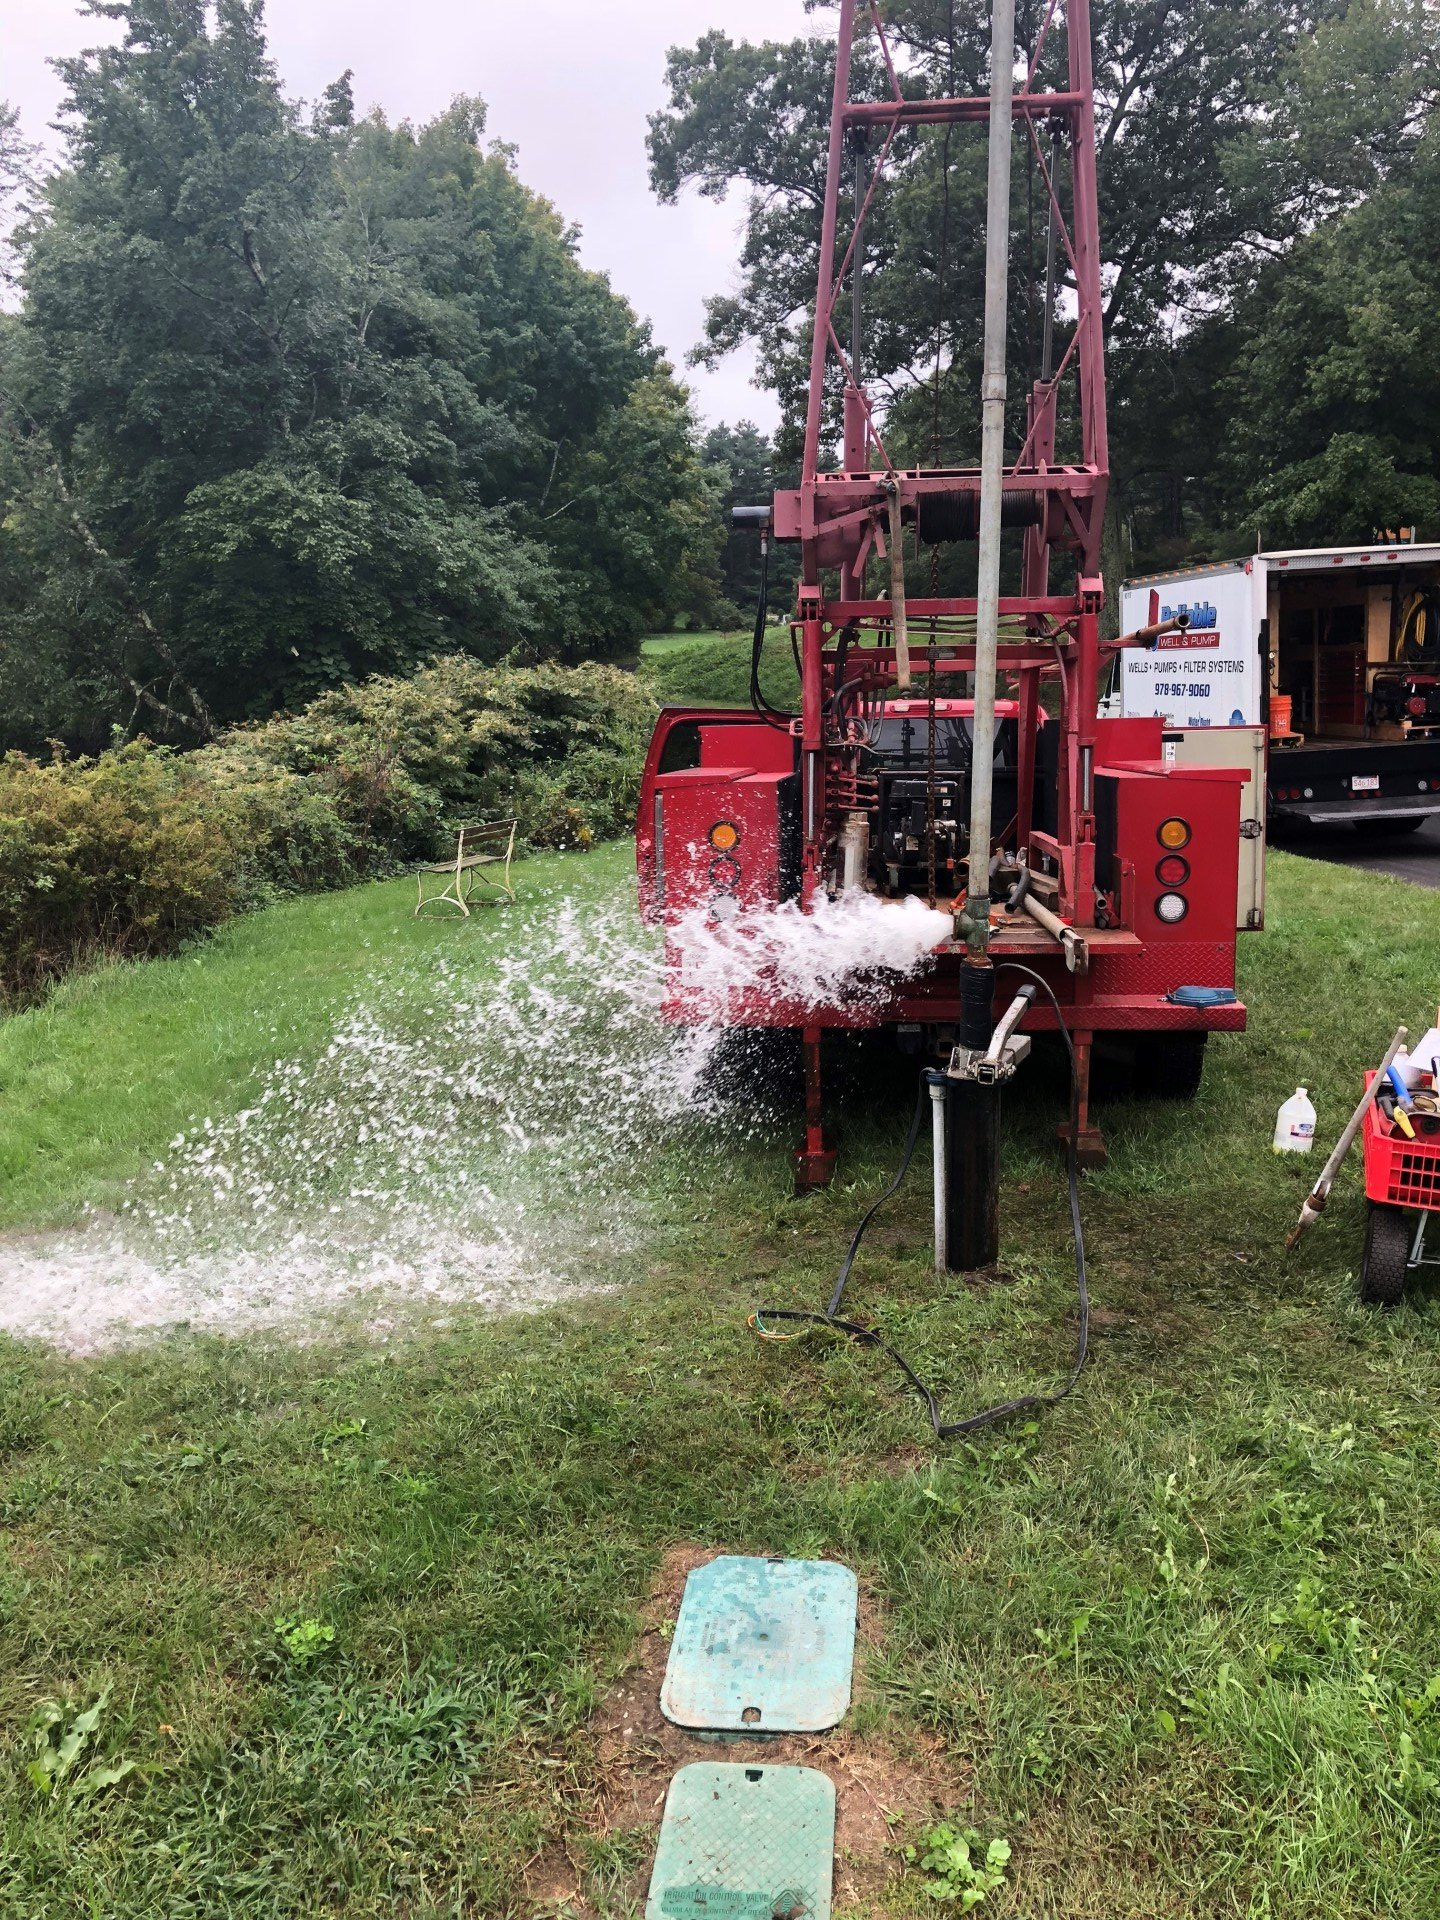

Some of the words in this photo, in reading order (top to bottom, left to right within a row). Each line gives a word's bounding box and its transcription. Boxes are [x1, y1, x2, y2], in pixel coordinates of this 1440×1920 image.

[1160, 637, 1180, 647] WELL
[1182, 637, 1188, 646] &
[1191, 635, 1216, 645] PUMP
[1128, 662, 1149, 673] WELLS
[1154, 661, 1178, 673] PUMPS
[1183, 661, 1207, 673] FILTER
[1208, 660, 1245, 673] SYSTEMS
[1154, 683, 1211, 697] 978-967-9060
[664, 1891, 707, 1901] IRRIGATION
[709, 1892, 742, 1902] CONTROL
[745, 1893, 769, 1903] VALVE
